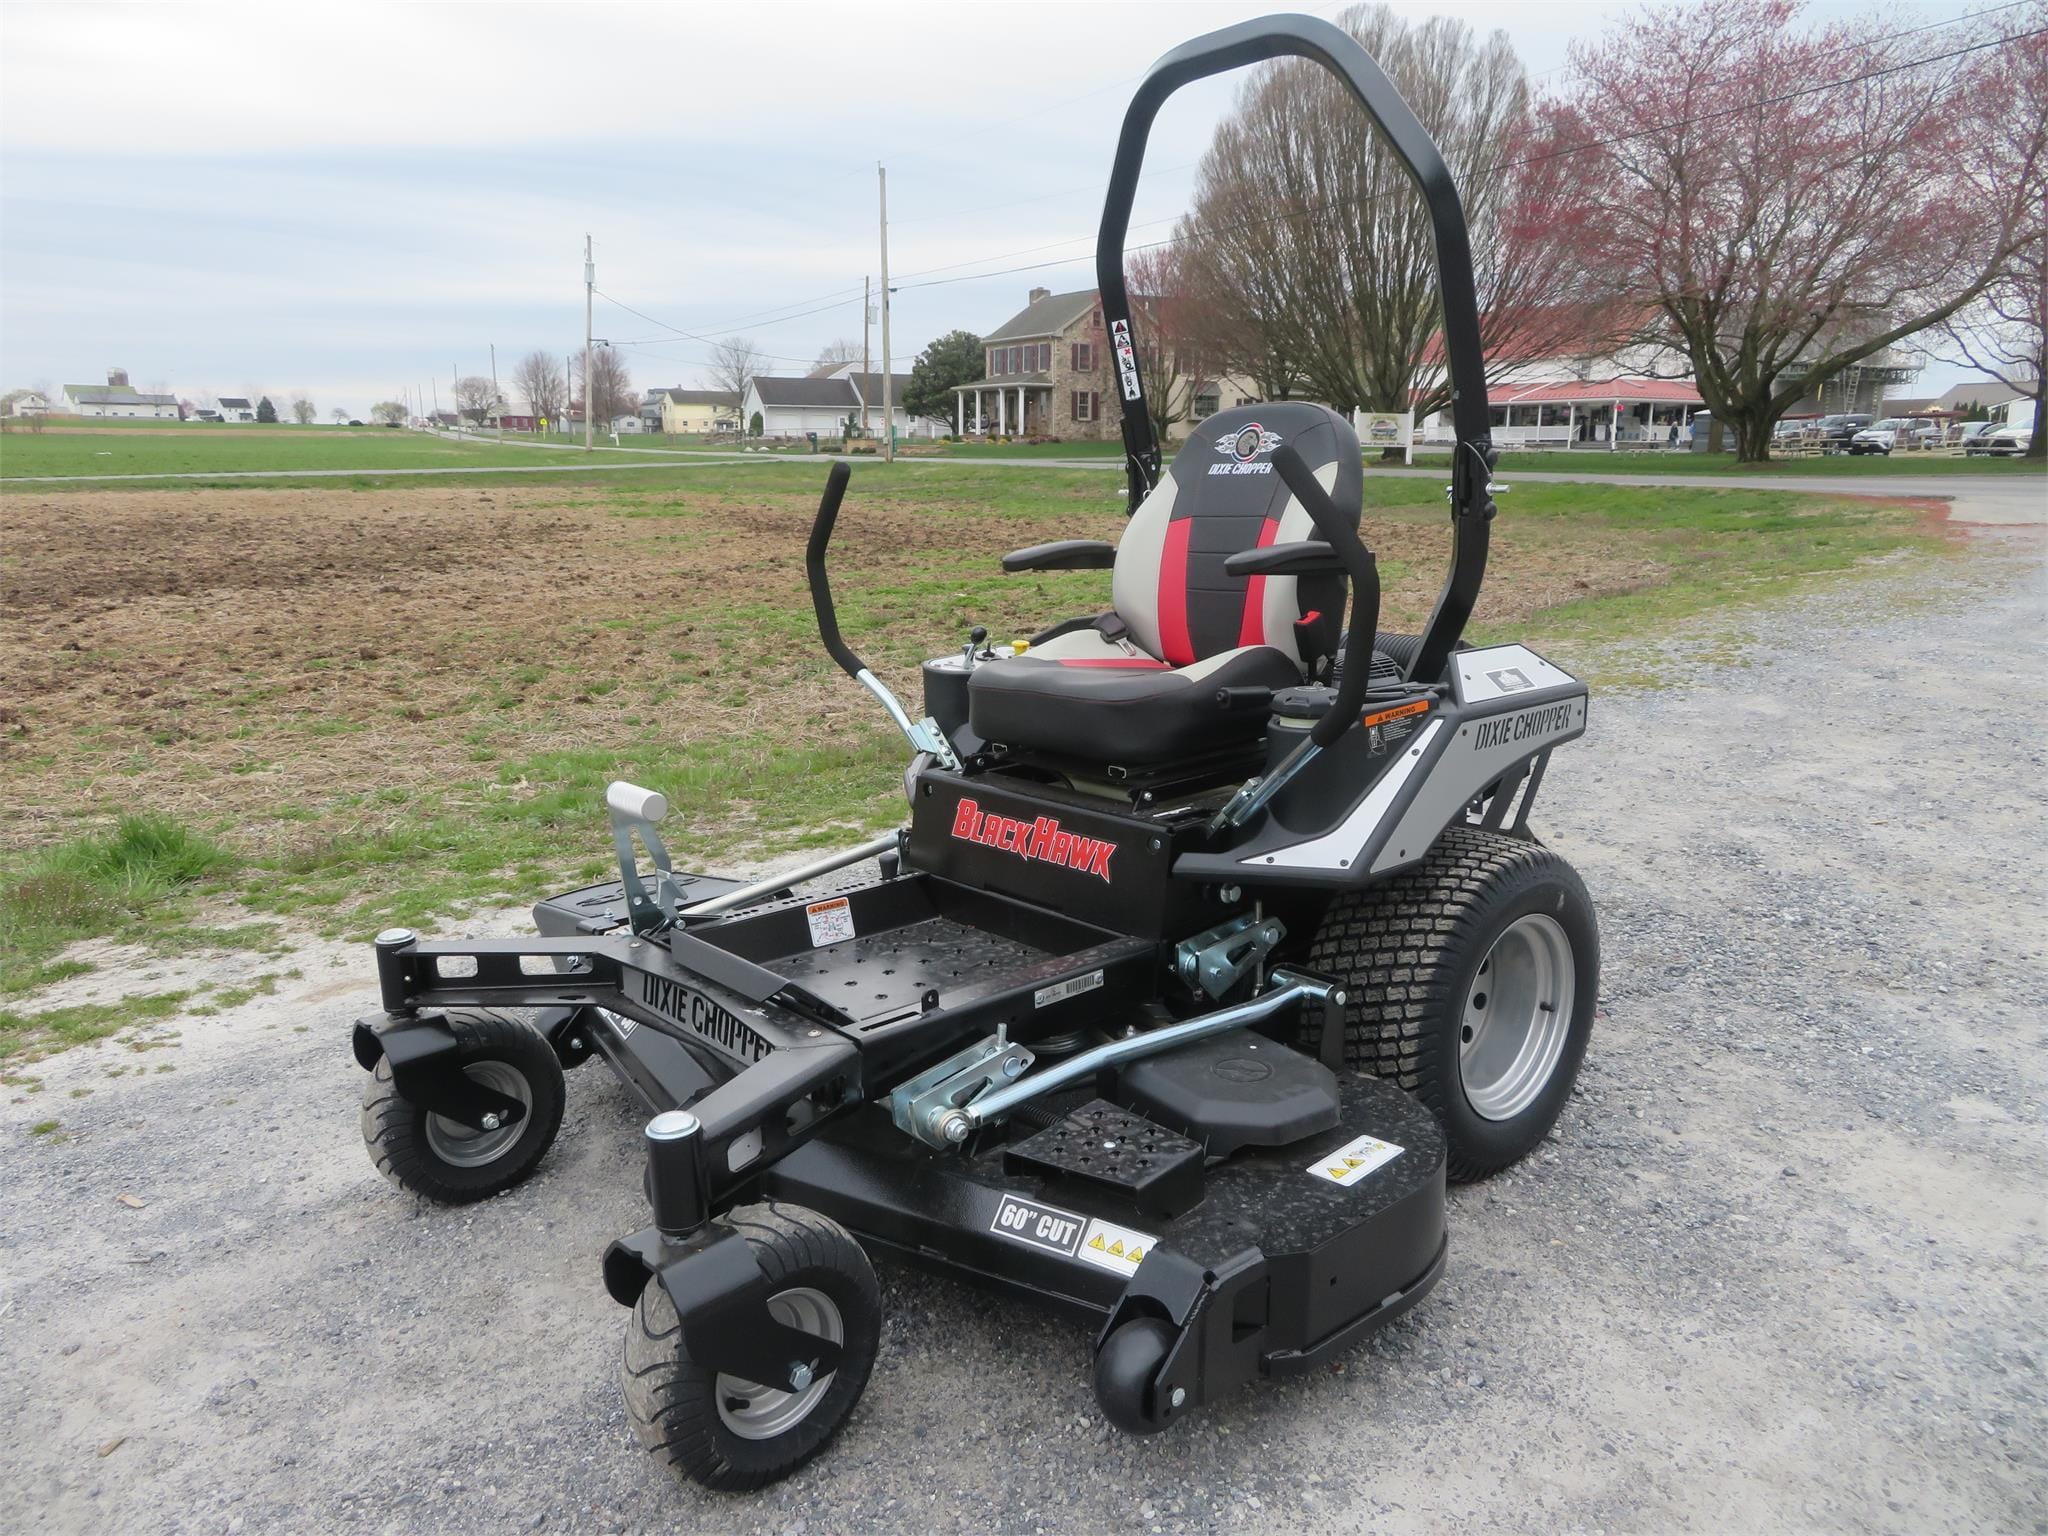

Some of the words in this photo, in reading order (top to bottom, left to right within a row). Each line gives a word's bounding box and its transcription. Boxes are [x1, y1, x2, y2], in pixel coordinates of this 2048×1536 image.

[1207, 463, 1234, 475] DIXIE
[1232, 462, 1273, 475] CHOPPER
[1384, 706, 1416, 720] WARNING
[1475, 717, 1514, 751] DIXIE
[1513, 703, 1572, 741] CHOPPER
[643, 974, 688, 1025] DIXIE
[1035, 1215, 1078, 1245] CUT
